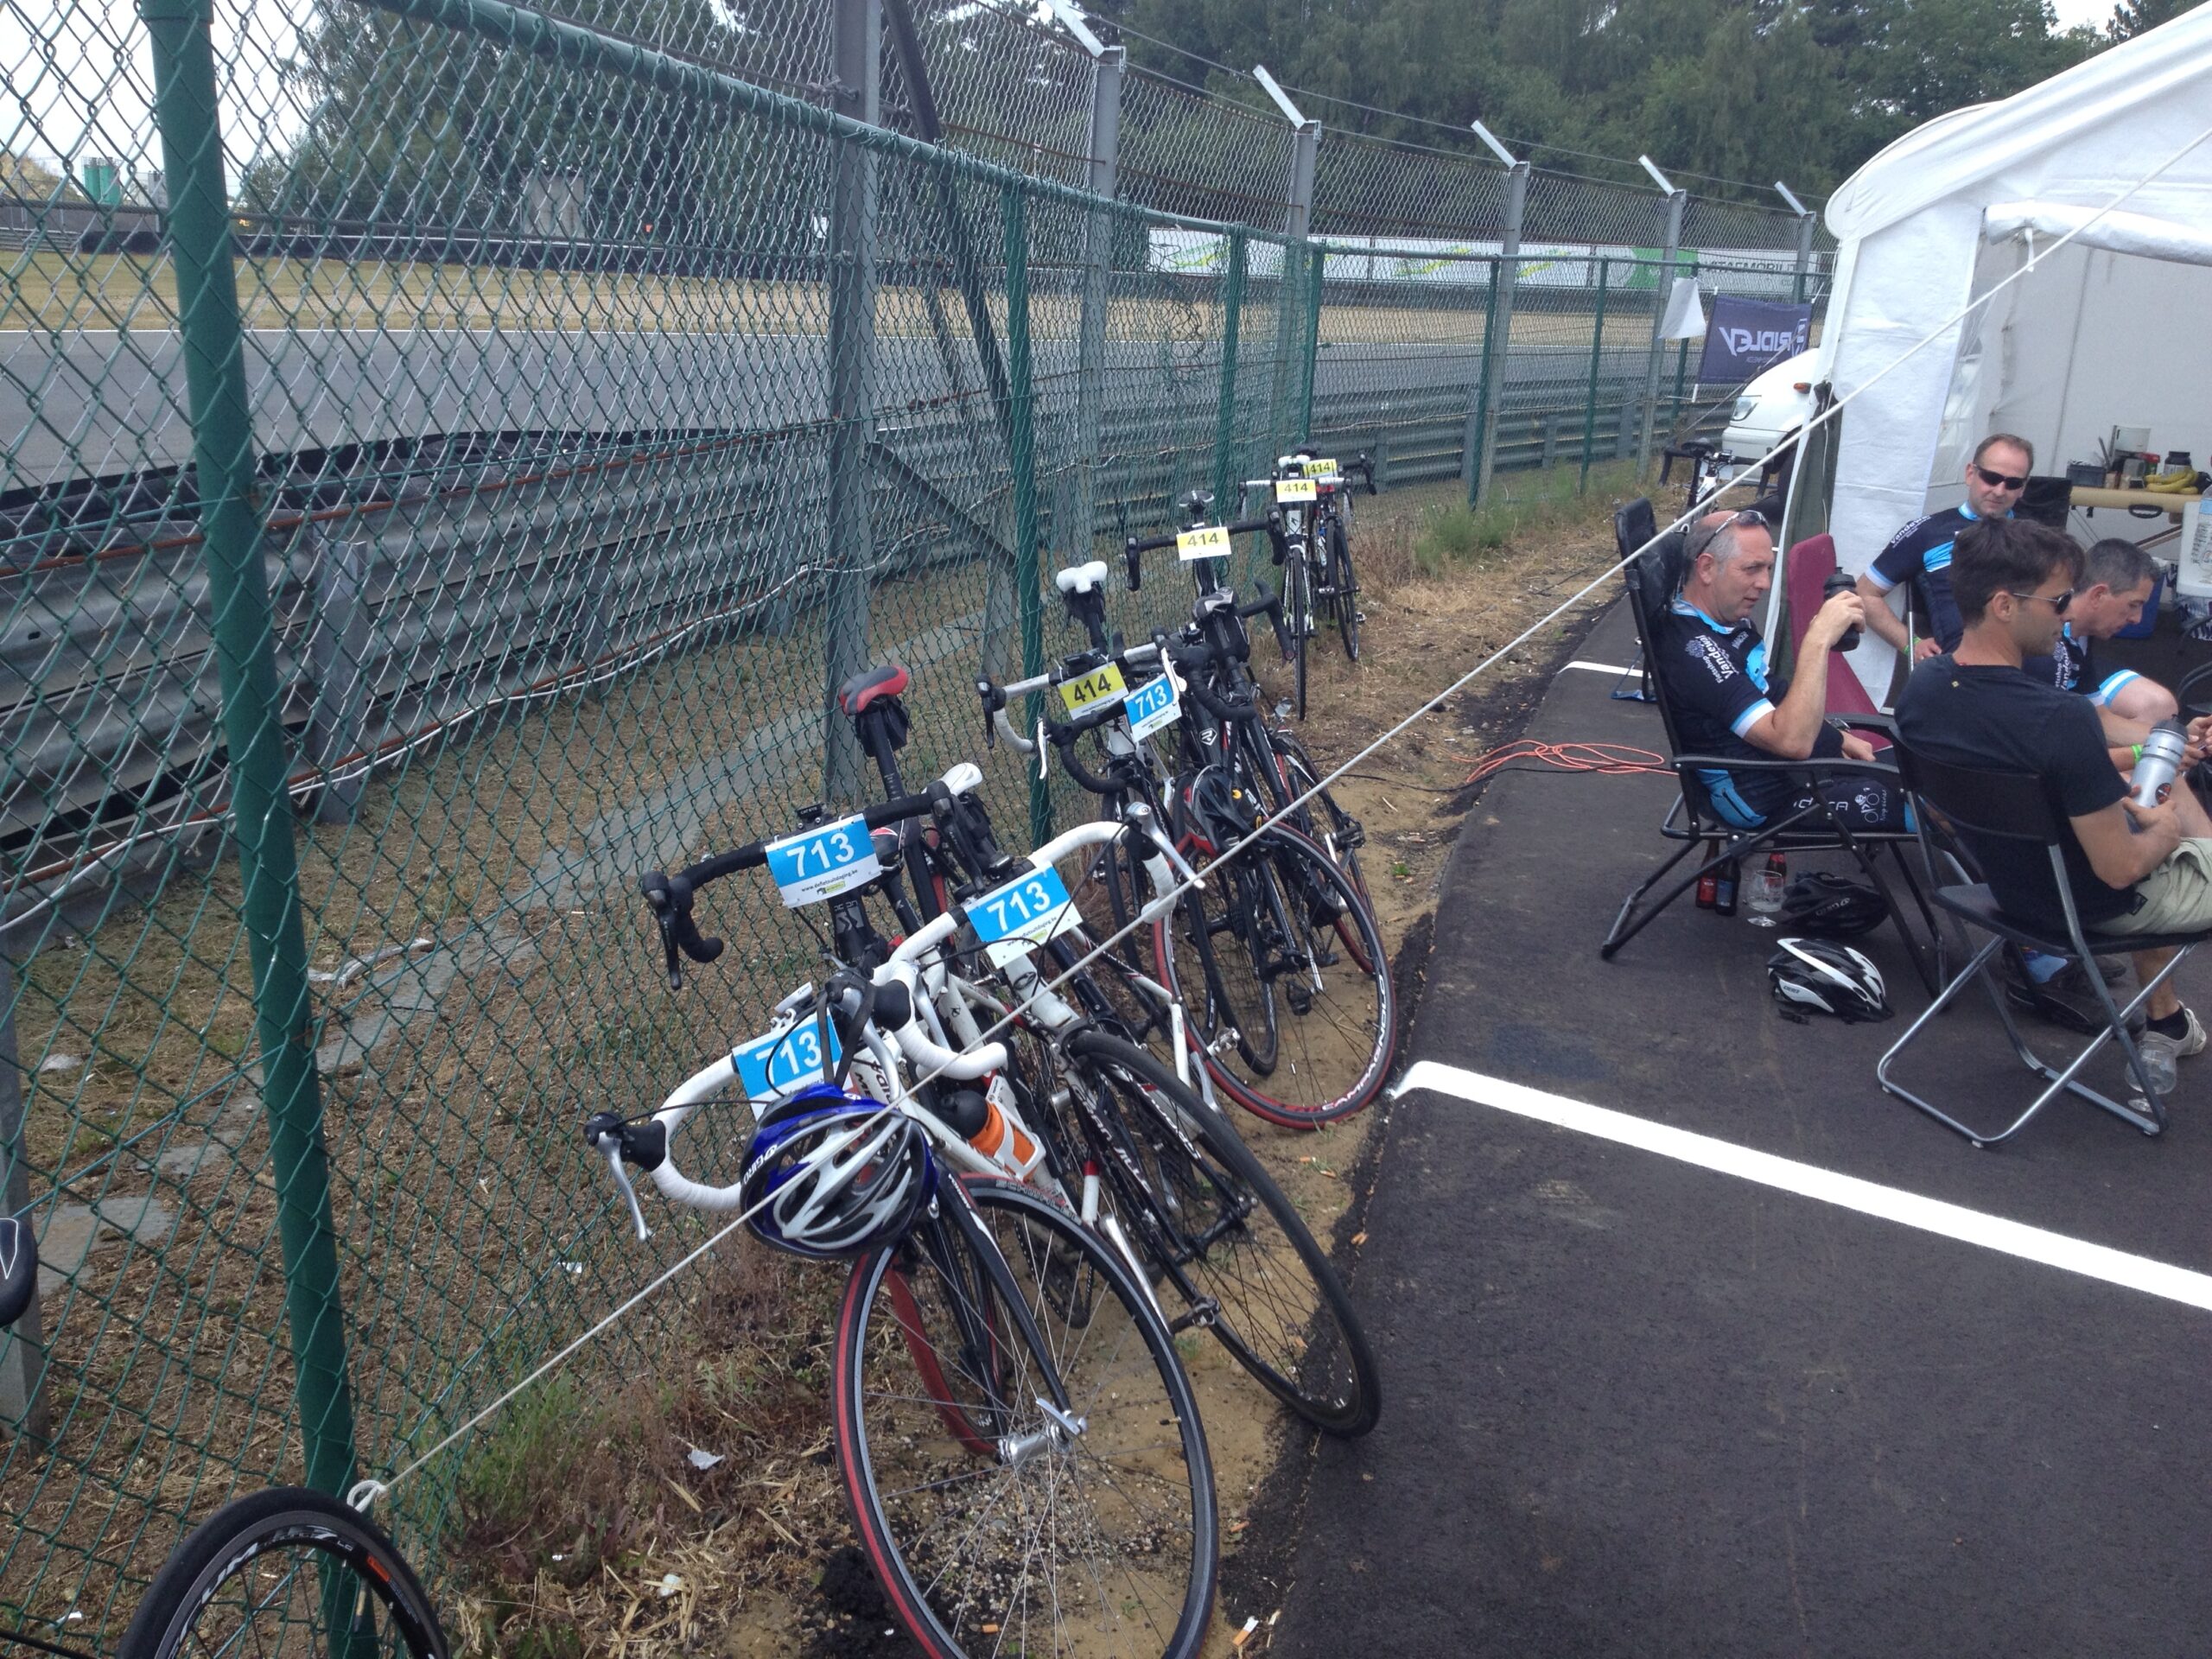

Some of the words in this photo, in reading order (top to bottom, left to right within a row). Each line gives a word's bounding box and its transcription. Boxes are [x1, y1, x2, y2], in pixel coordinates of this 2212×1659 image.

[1310, 461, 1331, 474] 414
[1284, 483, 1308, 493] 414
[1187, 532, 1219, 547] 414
[1074, 673, 1111, 702] 414
[1135, 684, 1167, 718] 713
[786, 832, 855, 878] 713
[986, 881, 1051, 932] 713
[743, 1154, 764, 1185] GIRO
